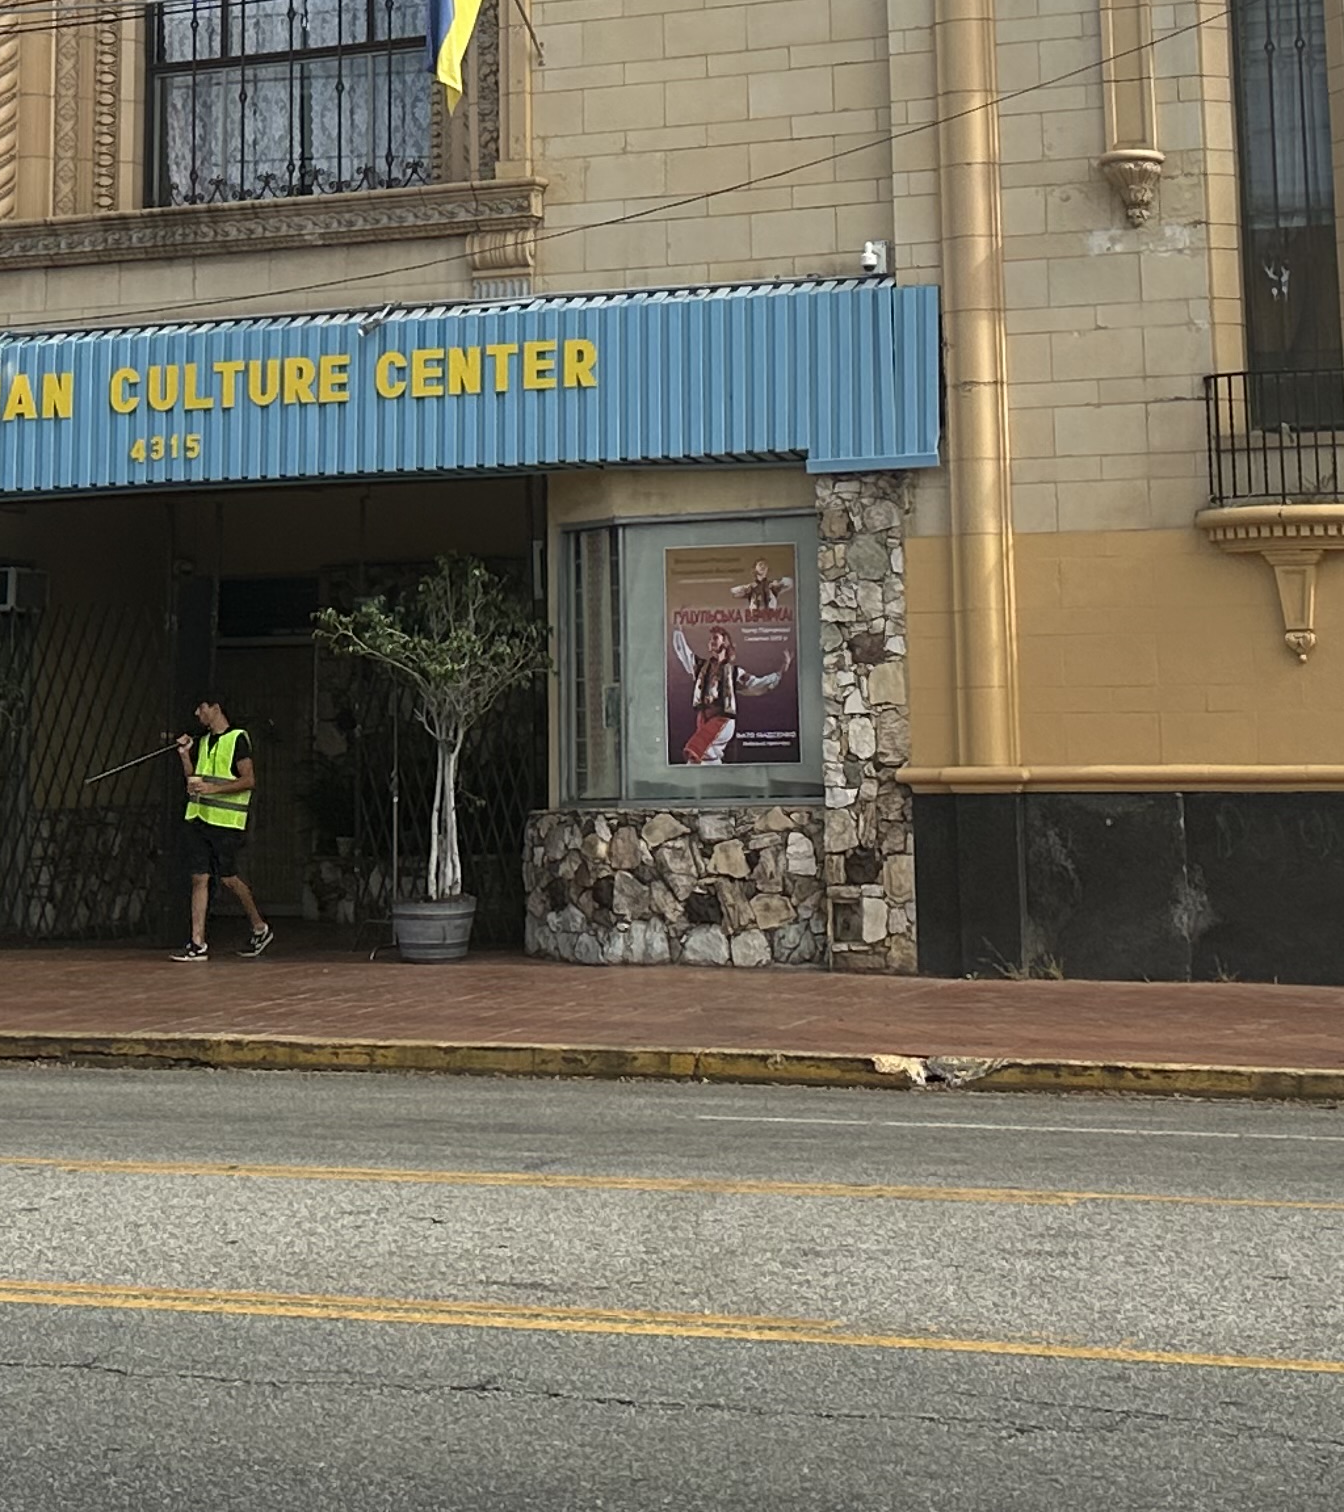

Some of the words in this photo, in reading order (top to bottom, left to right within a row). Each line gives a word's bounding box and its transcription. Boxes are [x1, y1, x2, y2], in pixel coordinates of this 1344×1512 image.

[109, 353, 351, 414] CULTURE
[375, 338, 598, 399] CENTER
[130, 433, 202, 464] 4315
